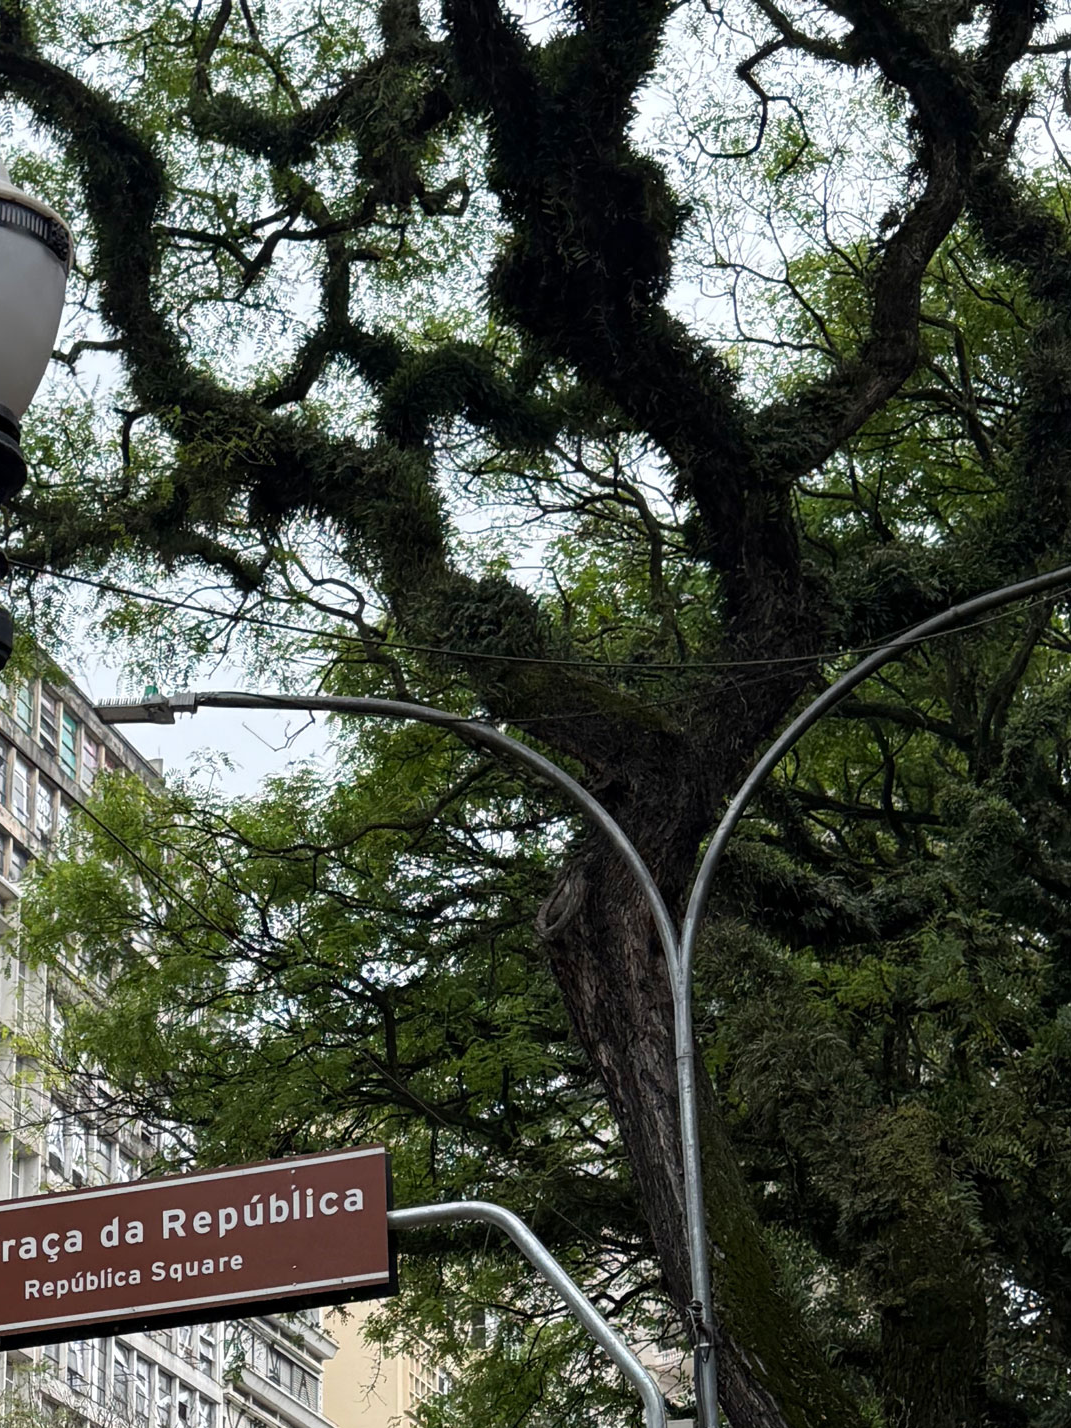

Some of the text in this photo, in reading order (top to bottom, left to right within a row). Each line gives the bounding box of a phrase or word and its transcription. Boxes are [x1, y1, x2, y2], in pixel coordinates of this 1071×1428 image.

[100, 1216, 144, 1248] da
[162, 1188, 364, 1239] República
[25, 1254, 244, 1300] República Square
